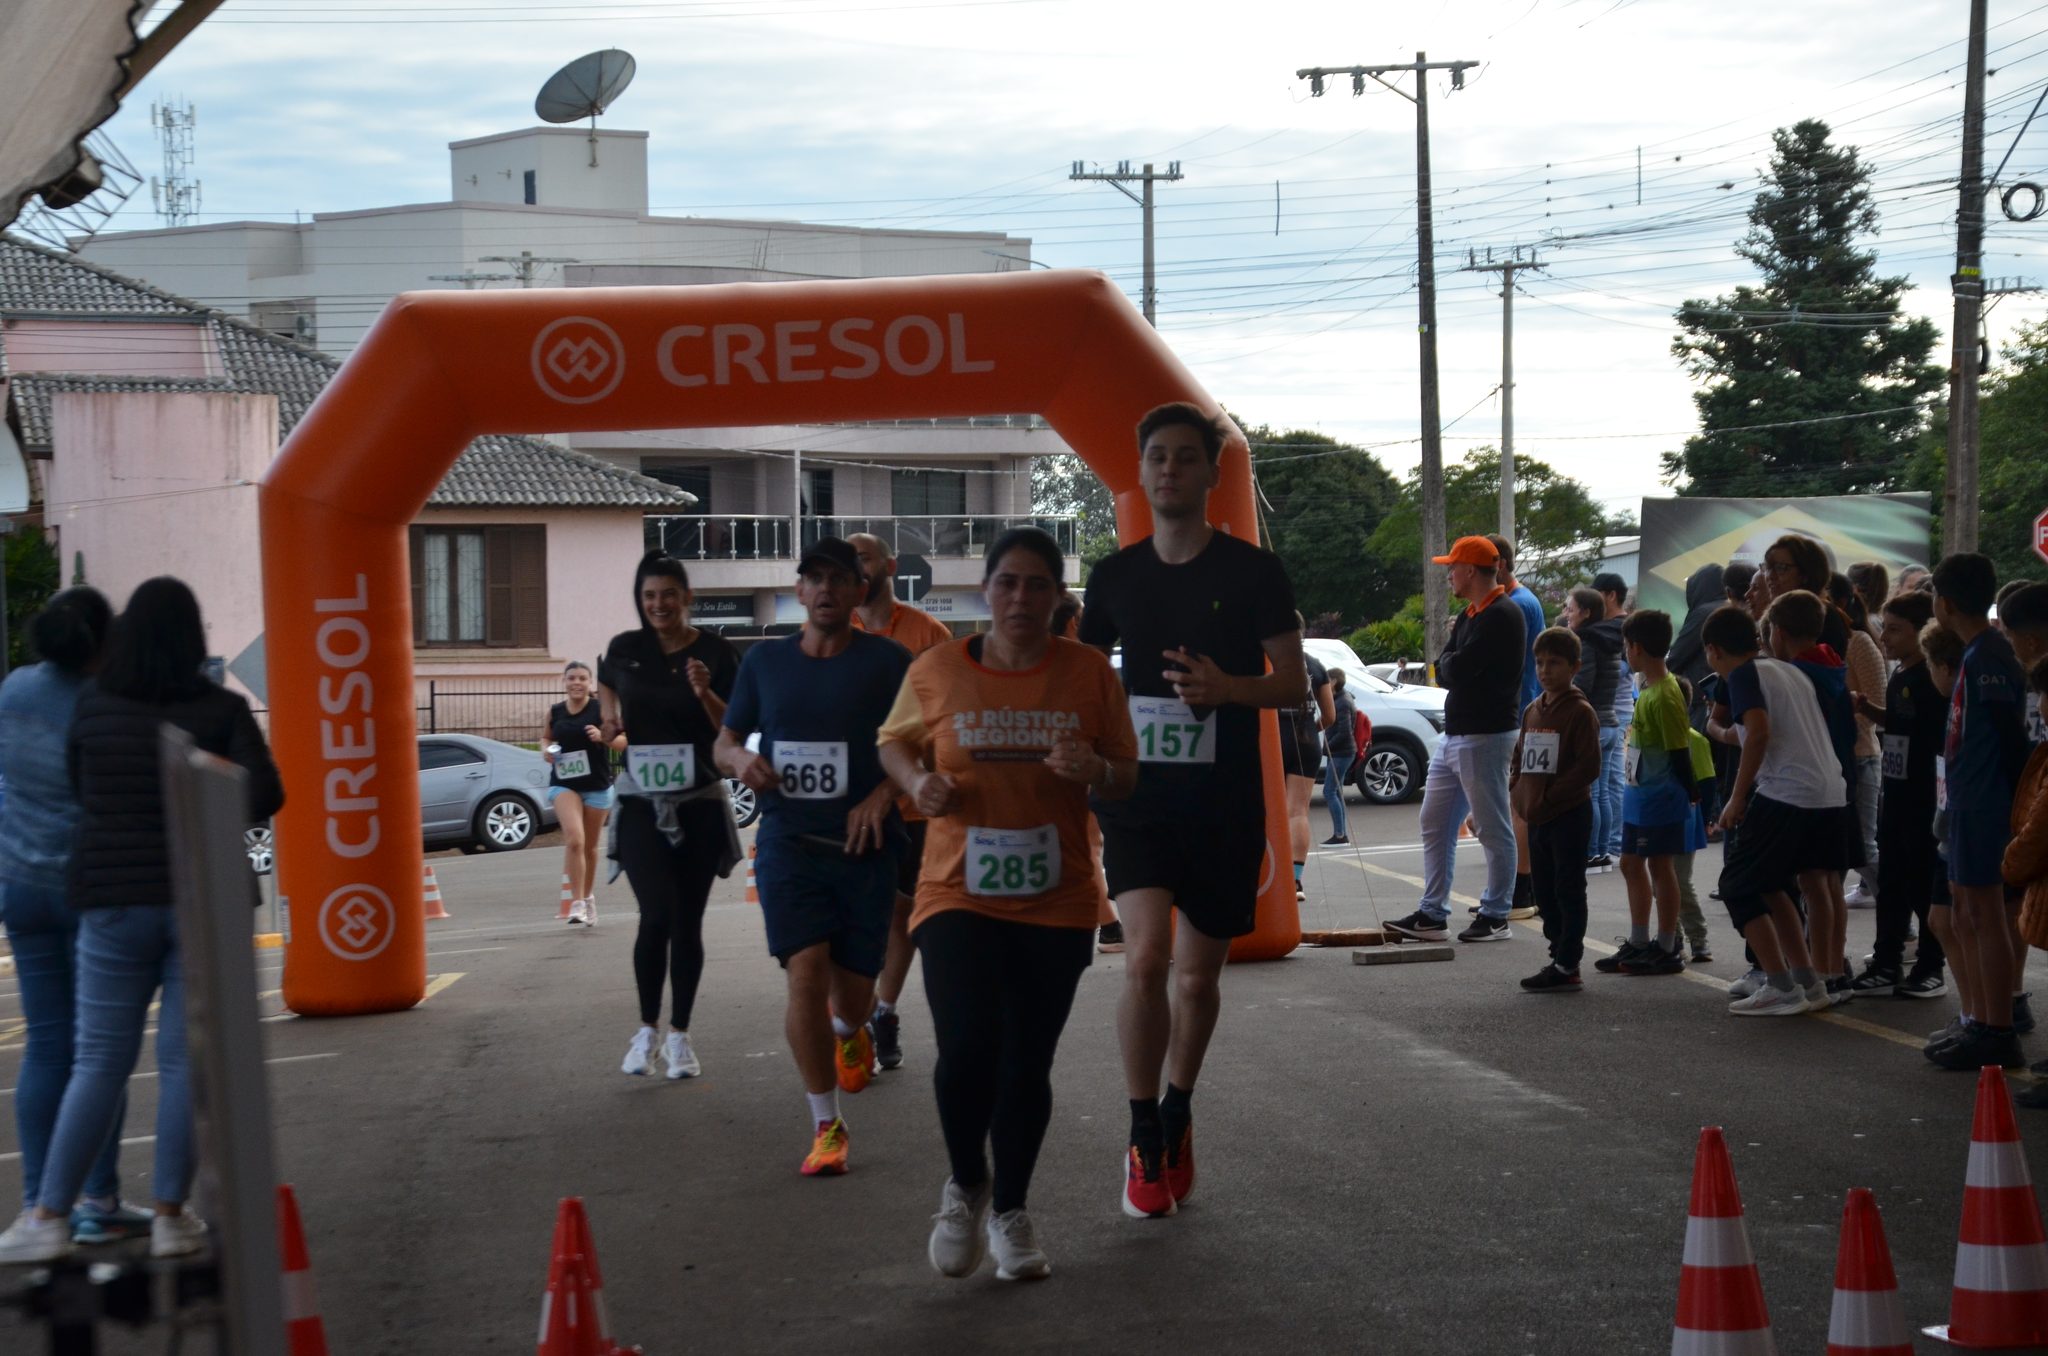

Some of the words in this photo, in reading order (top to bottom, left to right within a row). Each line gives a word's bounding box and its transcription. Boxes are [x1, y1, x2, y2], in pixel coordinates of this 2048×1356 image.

[656, 312, 995, 387] CRESOL
[703, 602, 715, 611] Seu
[314, 573, 380, 858] CRESOL
[981, 705, 1080, 730] RÚSTICA
[1141, 722, 1204, 757] 157
[559, 759, 585, 776] 340
[1523, 748, 1550, 770] 04
[638, 761, 687, 787] 104
[783, 763, 836, 793] 668
[979, 852, 1049, 888] 285
